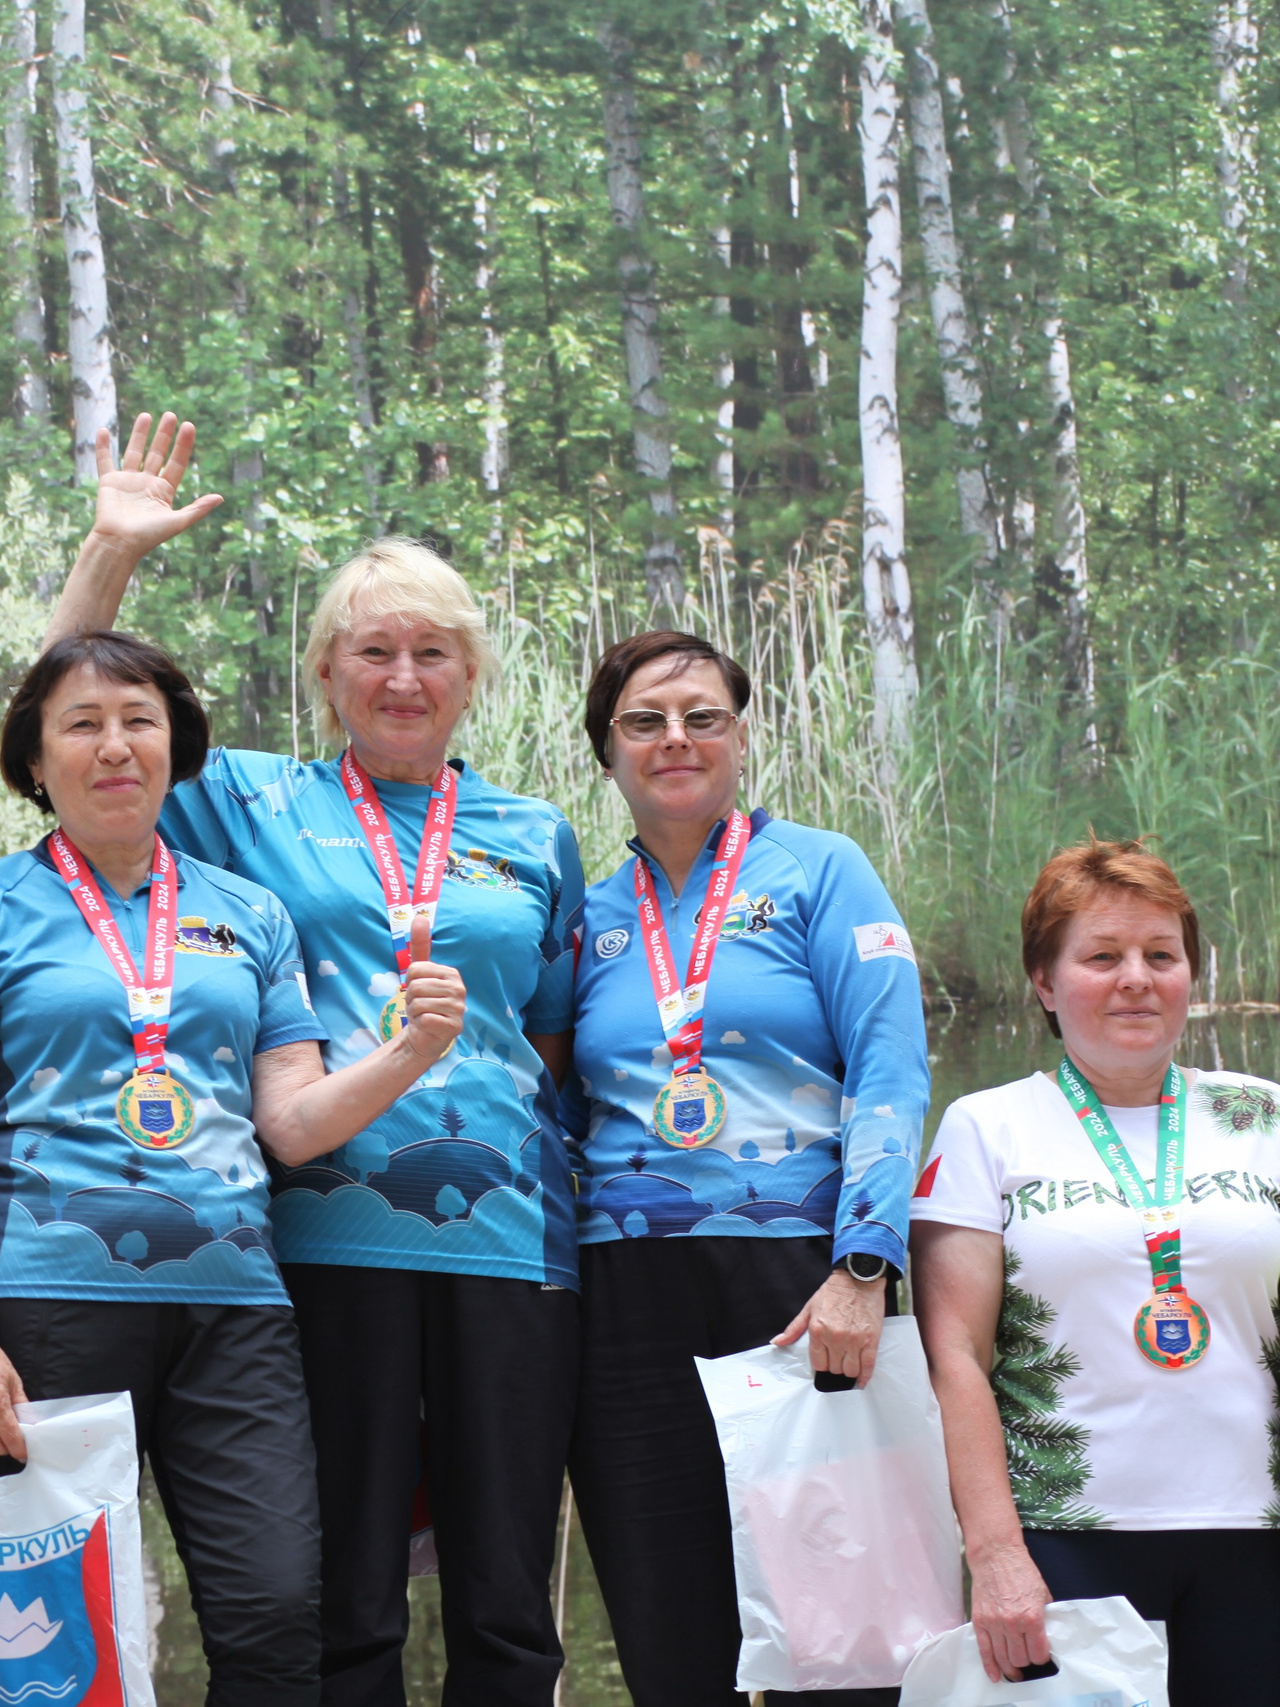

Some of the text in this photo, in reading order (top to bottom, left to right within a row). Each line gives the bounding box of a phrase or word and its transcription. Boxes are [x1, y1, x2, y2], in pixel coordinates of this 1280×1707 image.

[361, 802, 402, 900] ЧЕБАРКУЛЬ 2024
[420, 800, 448, 896] ЧЕБАРКУЛЬ 2024
[78, 885, 136, 983] ЧЕБАРКУЛЬ 2024
[152, 883, 170, 981] ЧЕБАРКУЛЬ 2024
[643, 898, 672, 994] ЧЕБАРКУЛЬ 2024
[692, 870, 731, 976] ЧЕБАРКУЛЬ 2024
[1086, 1111, 1145, 1203] ЧЕБАРКУЛЬ 2024
[1163, 1106, 1180, 1200] ЧЕБАРКУЛЬ 2024
